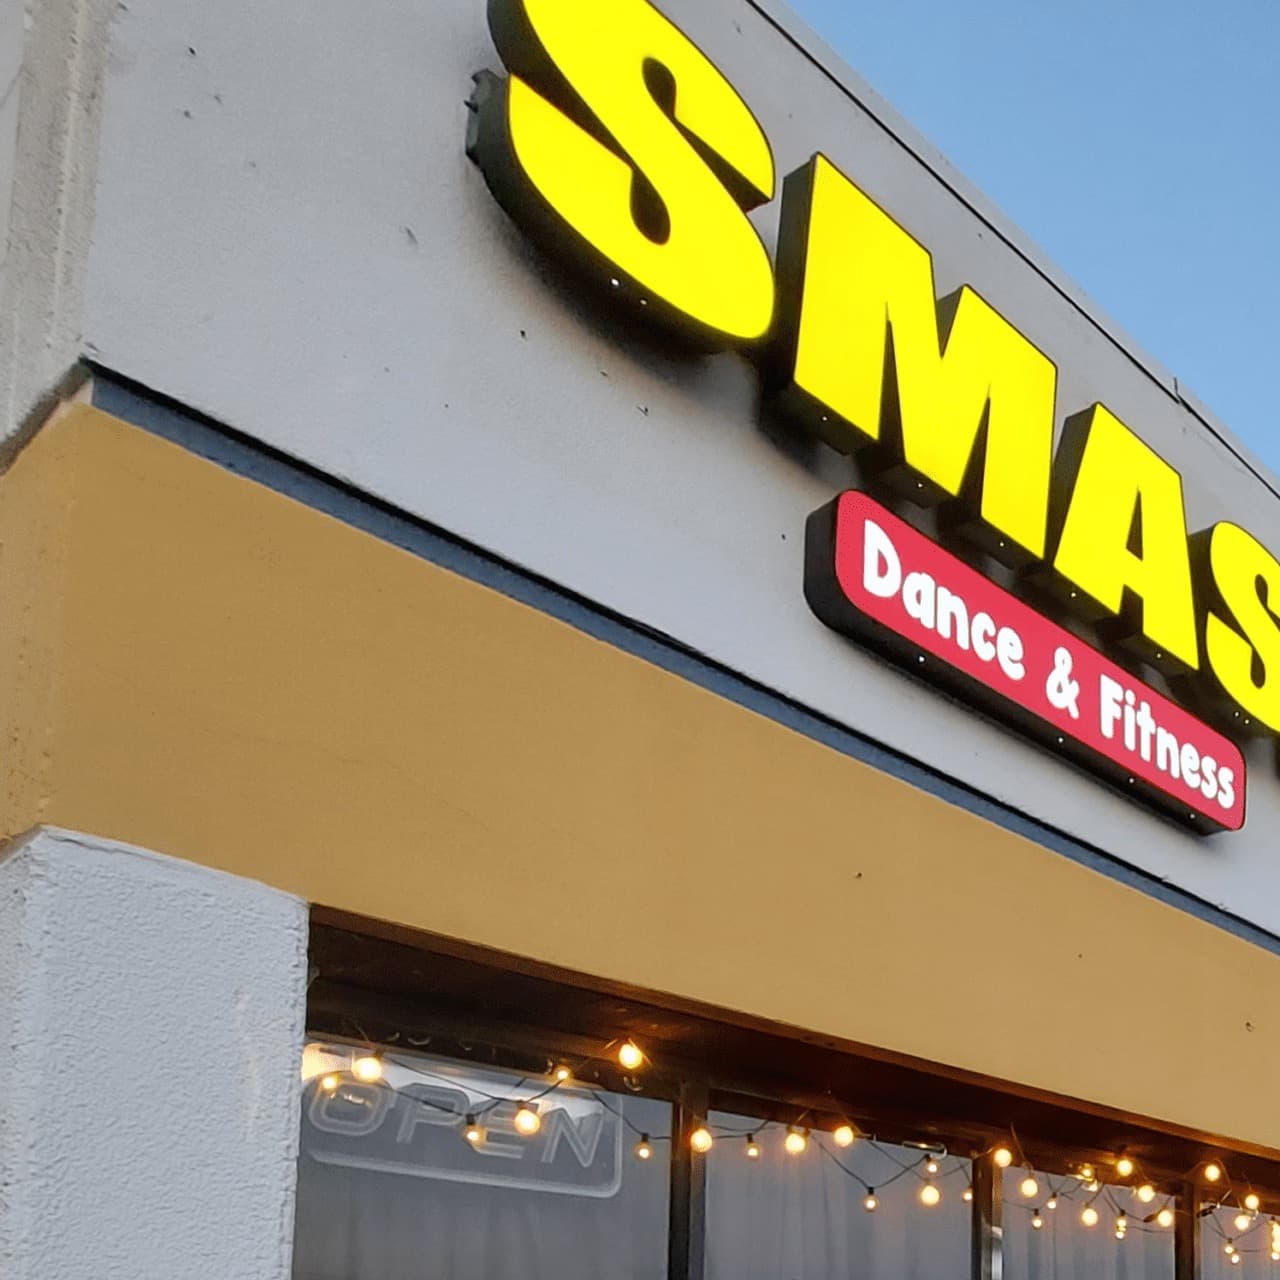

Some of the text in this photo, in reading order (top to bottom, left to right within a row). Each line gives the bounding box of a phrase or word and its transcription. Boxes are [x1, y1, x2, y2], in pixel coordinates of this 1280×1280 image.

[863, 518, 1235, 809] Dance & Fitness
[307, 1071, 606, 1168] OPEN
